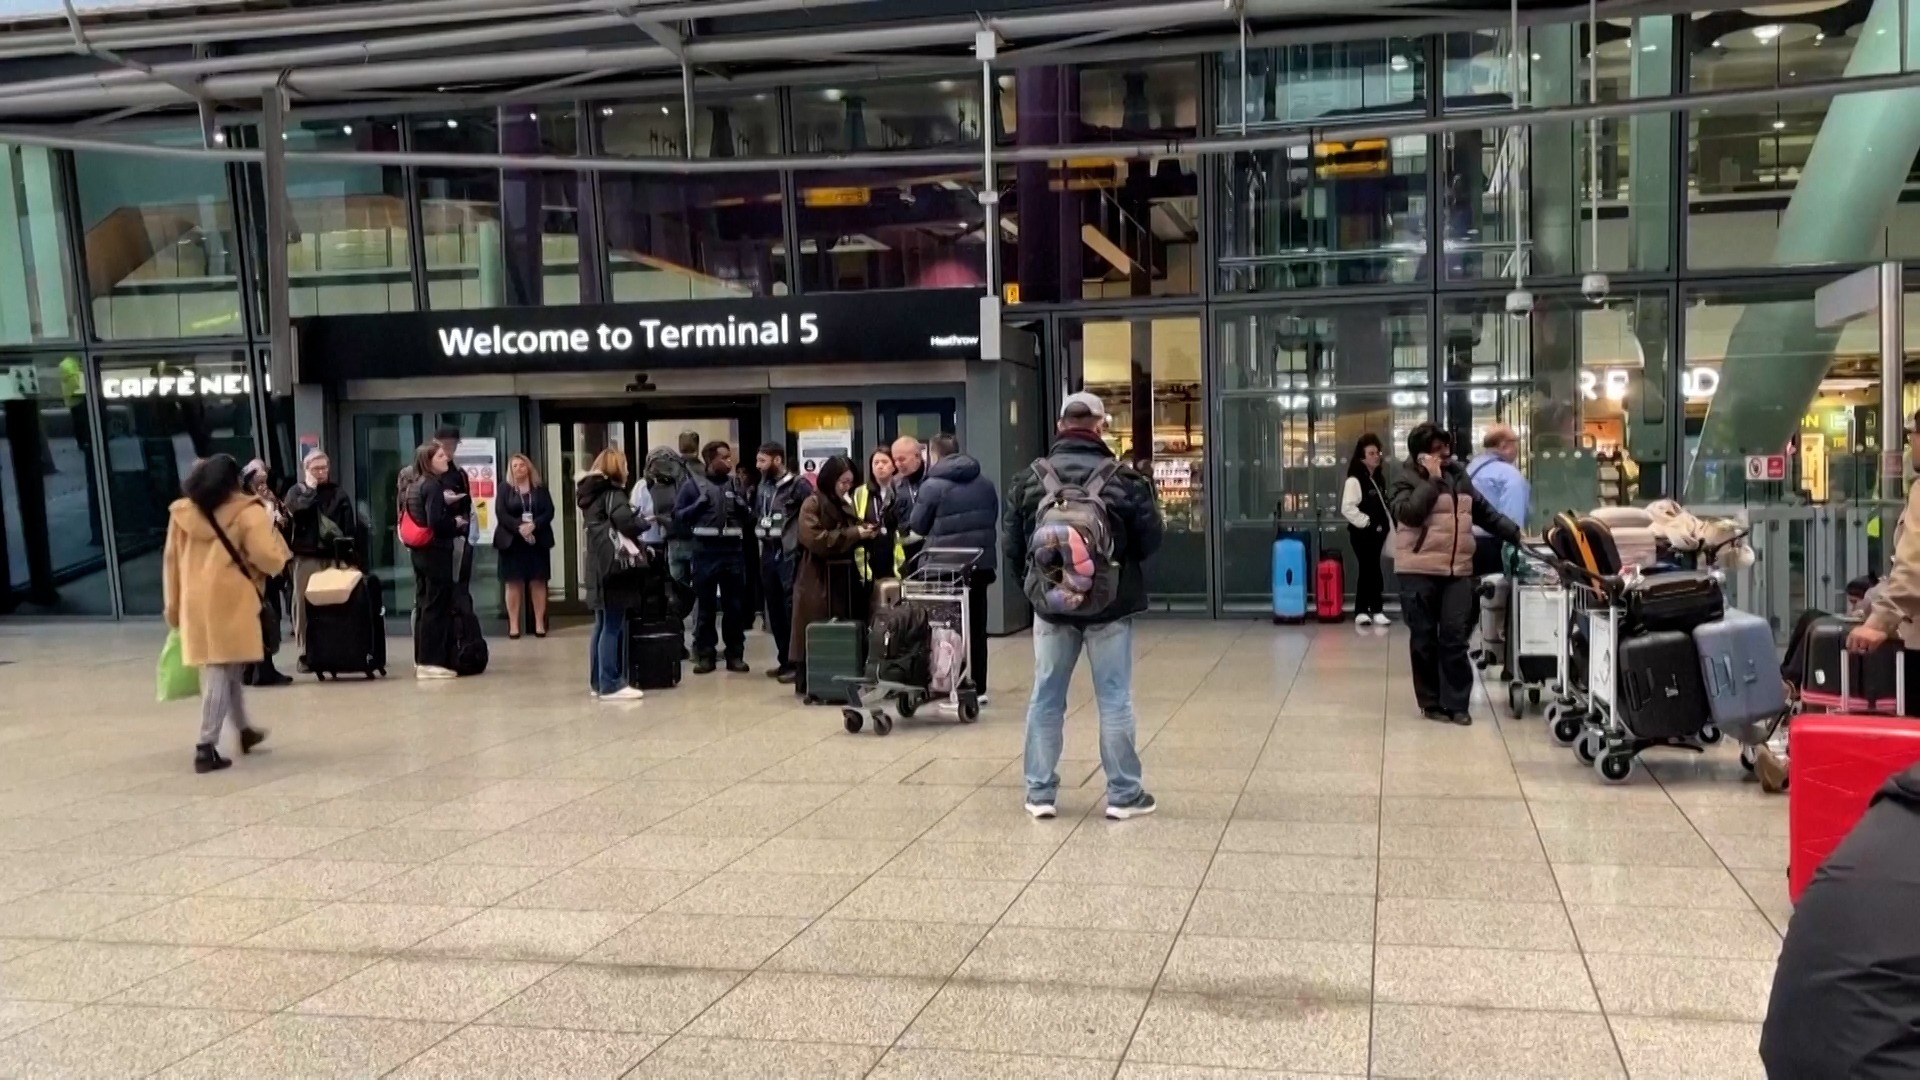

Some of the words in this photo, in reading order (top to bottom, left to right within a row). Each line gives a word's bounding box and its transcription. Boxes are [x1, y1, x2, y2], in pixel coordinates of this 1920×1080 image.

[438, 325, 589, 356] Welcome
[597, 323, 632, 351] to
[639, 313, 788, 348] Terminal
[800, 313, 819, 343] 5
[201, 374, 271, 395] NE
